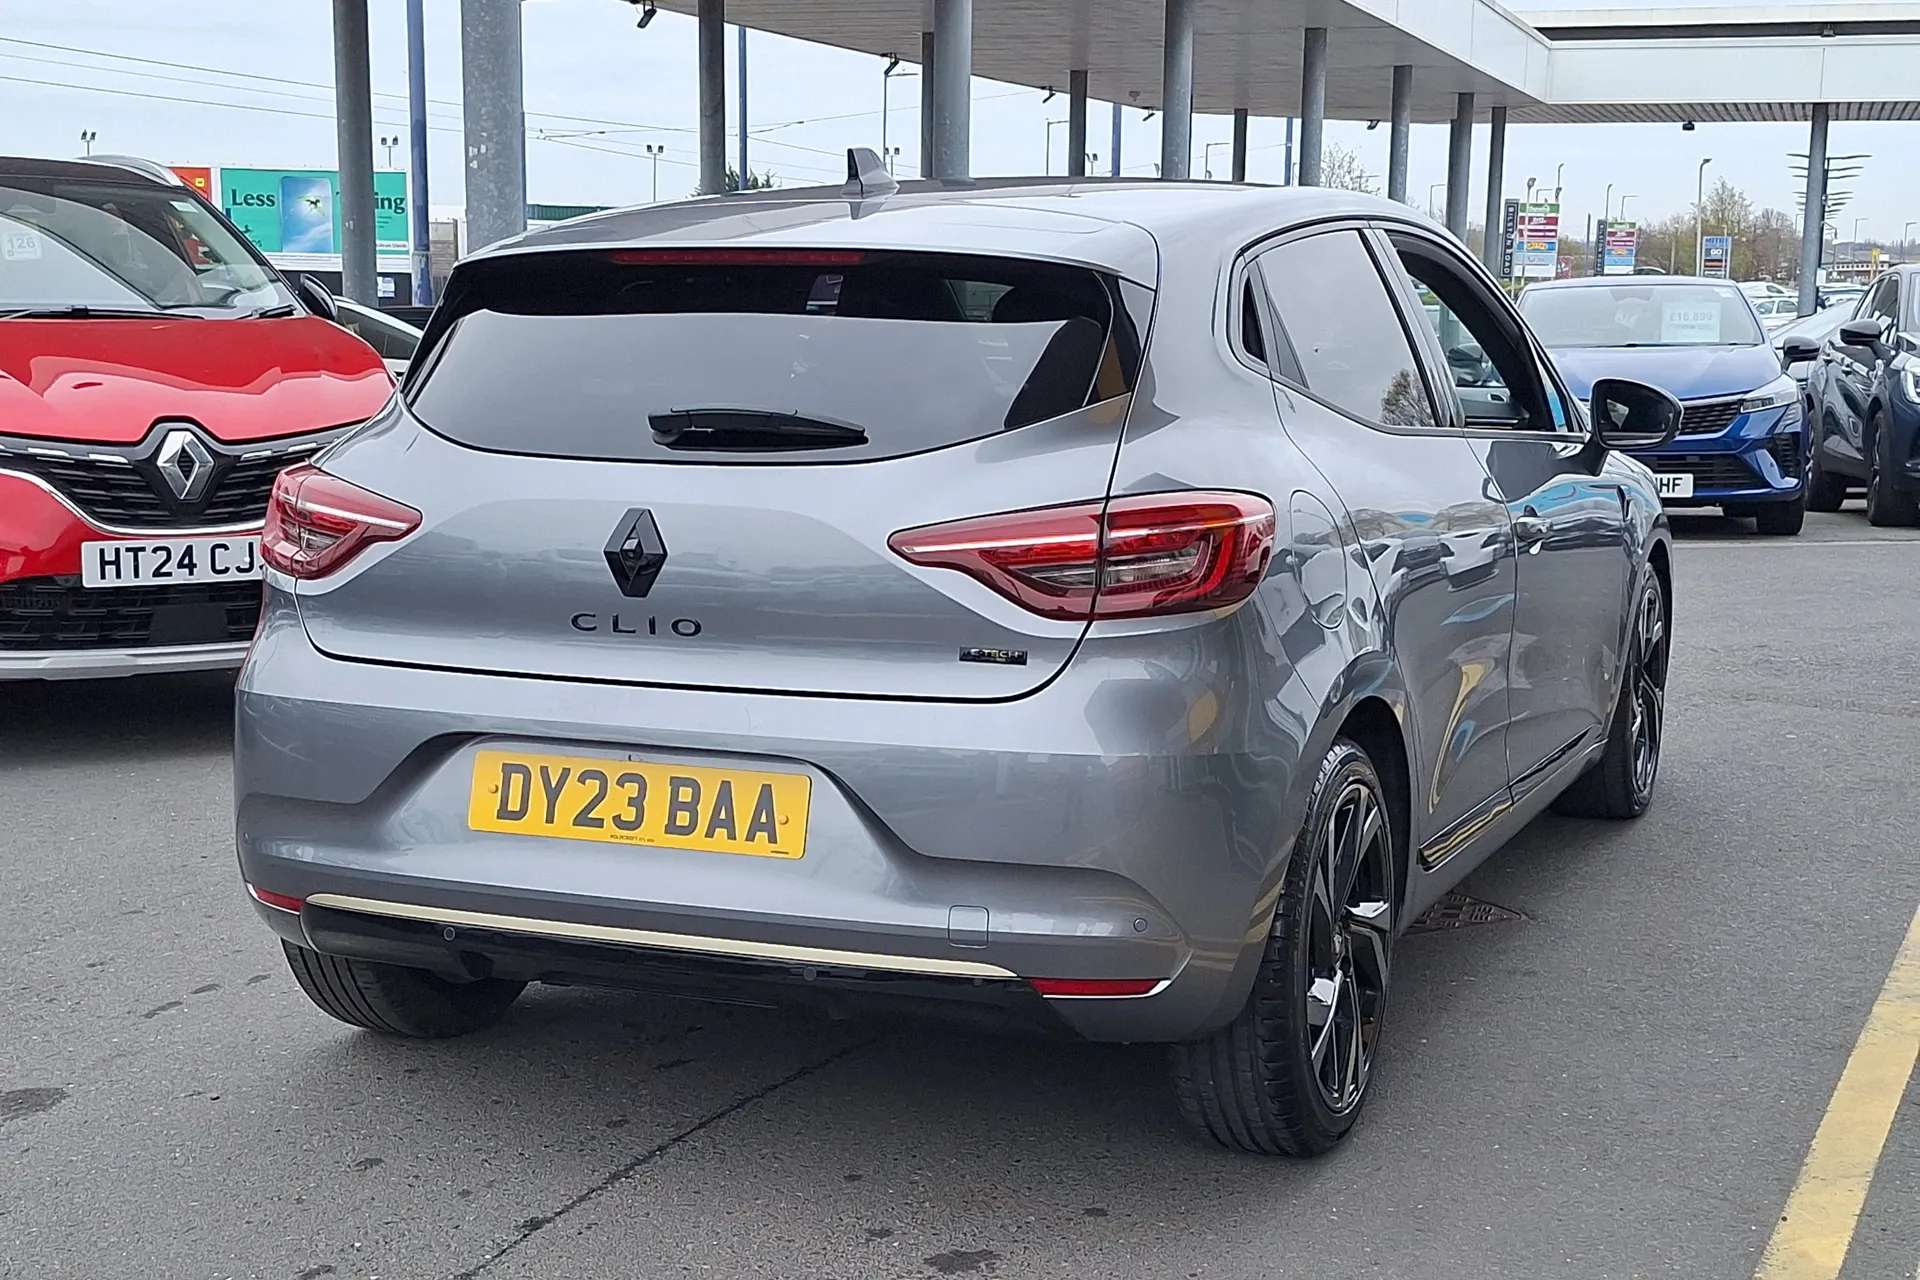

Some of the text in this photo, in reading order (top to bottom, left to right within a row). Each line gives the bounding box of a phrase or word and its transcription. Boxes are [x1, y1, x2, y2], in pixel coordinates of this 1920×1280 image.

[231, 188, 276, 207] Less
[99, 541, 264, 581] HT24 CJ
[570, 612, 702, 637] CLIO
[496, 762, 779, 845] DY23 BAA
